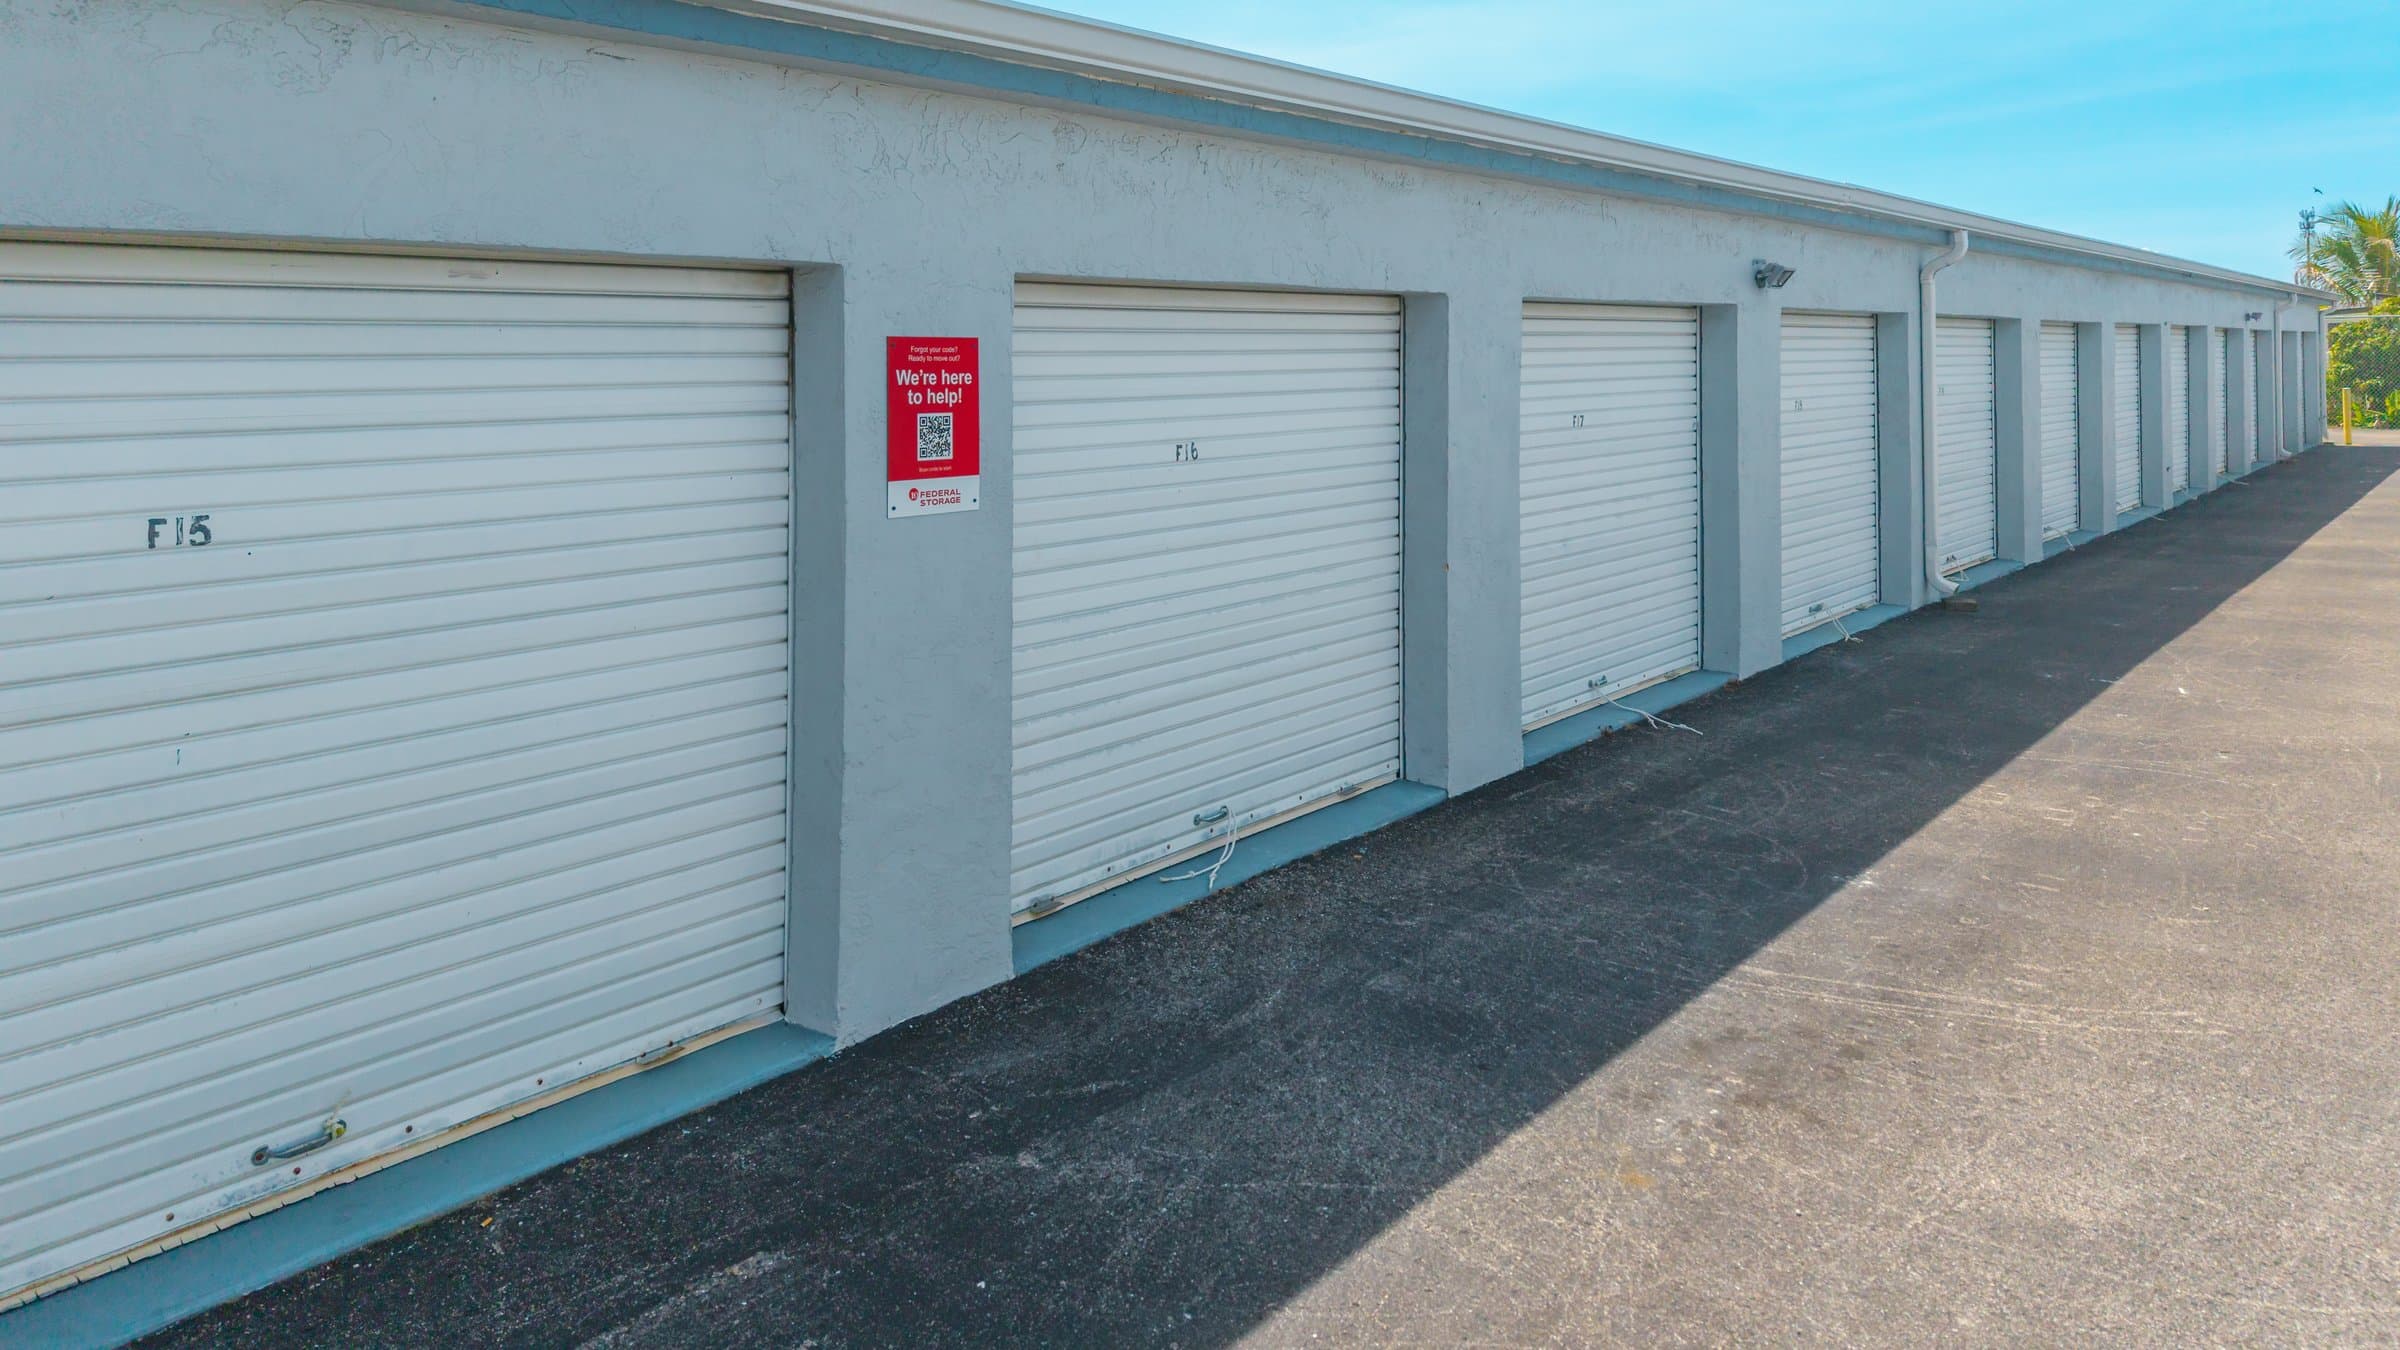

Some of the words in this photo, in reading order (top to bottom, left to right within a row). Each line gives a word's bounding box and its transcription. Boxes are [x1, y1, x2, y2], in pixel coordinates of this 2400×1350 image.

[910, 345, 928, 354] Forgot
[908, 354, 926, 363] Ready
[948, 354, 960, 362] out?
[895, 369, 937, 386] We're
[941, 369, 972, 385] here
[907, 389, 923, 405] to
[927, 387, 962, 407] help!
[1176, 441, 1199, 462] F16
[920, 488, 960, 498] FEDERAL
[920, 496, 960, 507] STORAGE
[147, 514, 212, 549] F15
